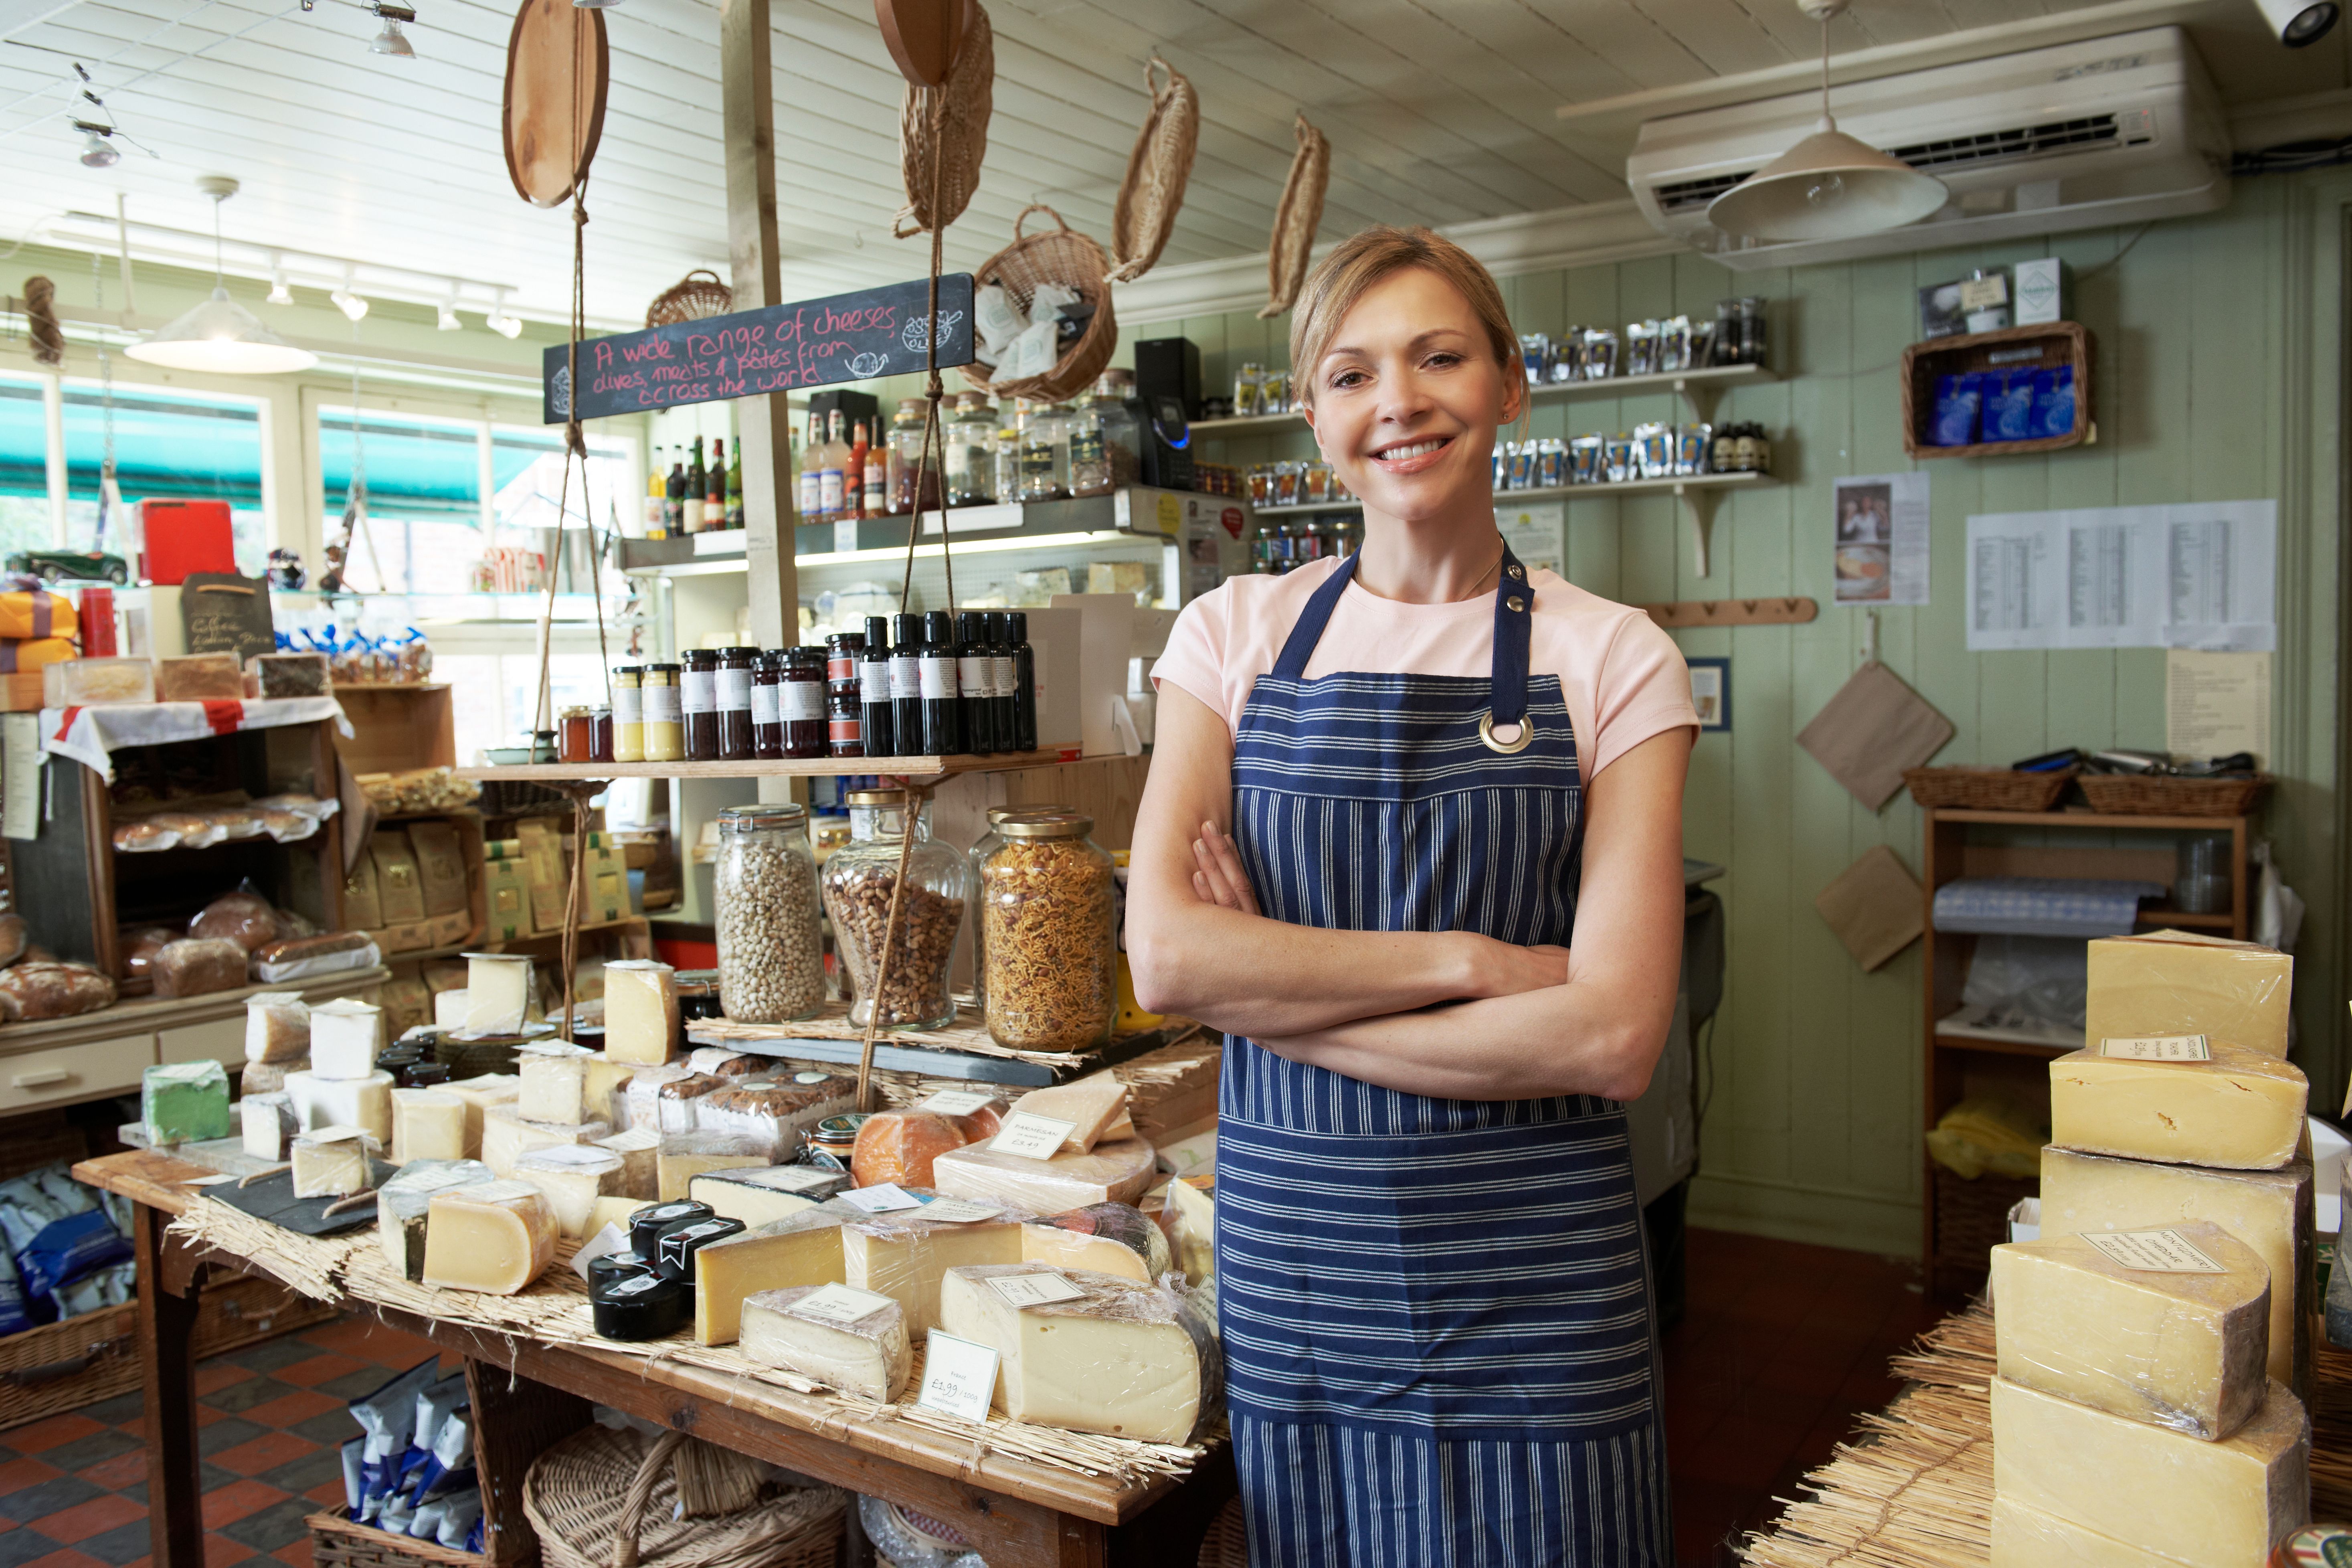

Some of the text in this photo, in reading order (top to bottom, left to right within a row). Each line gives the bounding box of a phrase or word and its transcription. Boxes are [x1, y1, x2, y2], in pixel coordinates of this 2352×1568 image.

[594, 306, 897, 371] A wide range of cheeses,
[651, 359, 711, 382] meats
[797, 340, 858, 369] from
[638, 383, 711, 405] across
[717, 375, 746, 396] the
[1014, 1124, 1059, 1136] PARMESAN
[1011, 1139, 1039, 1150] £3.49
[2145, 1239, 2182, 1263] CHEDDAR
[2156, 1231, 2216, 1270] MONTGOMERY
[951, 1371, 967, 1380] France
[932, 1379, 957, 1397] £1.99
[964, 1392, 978, 1403] 100g
